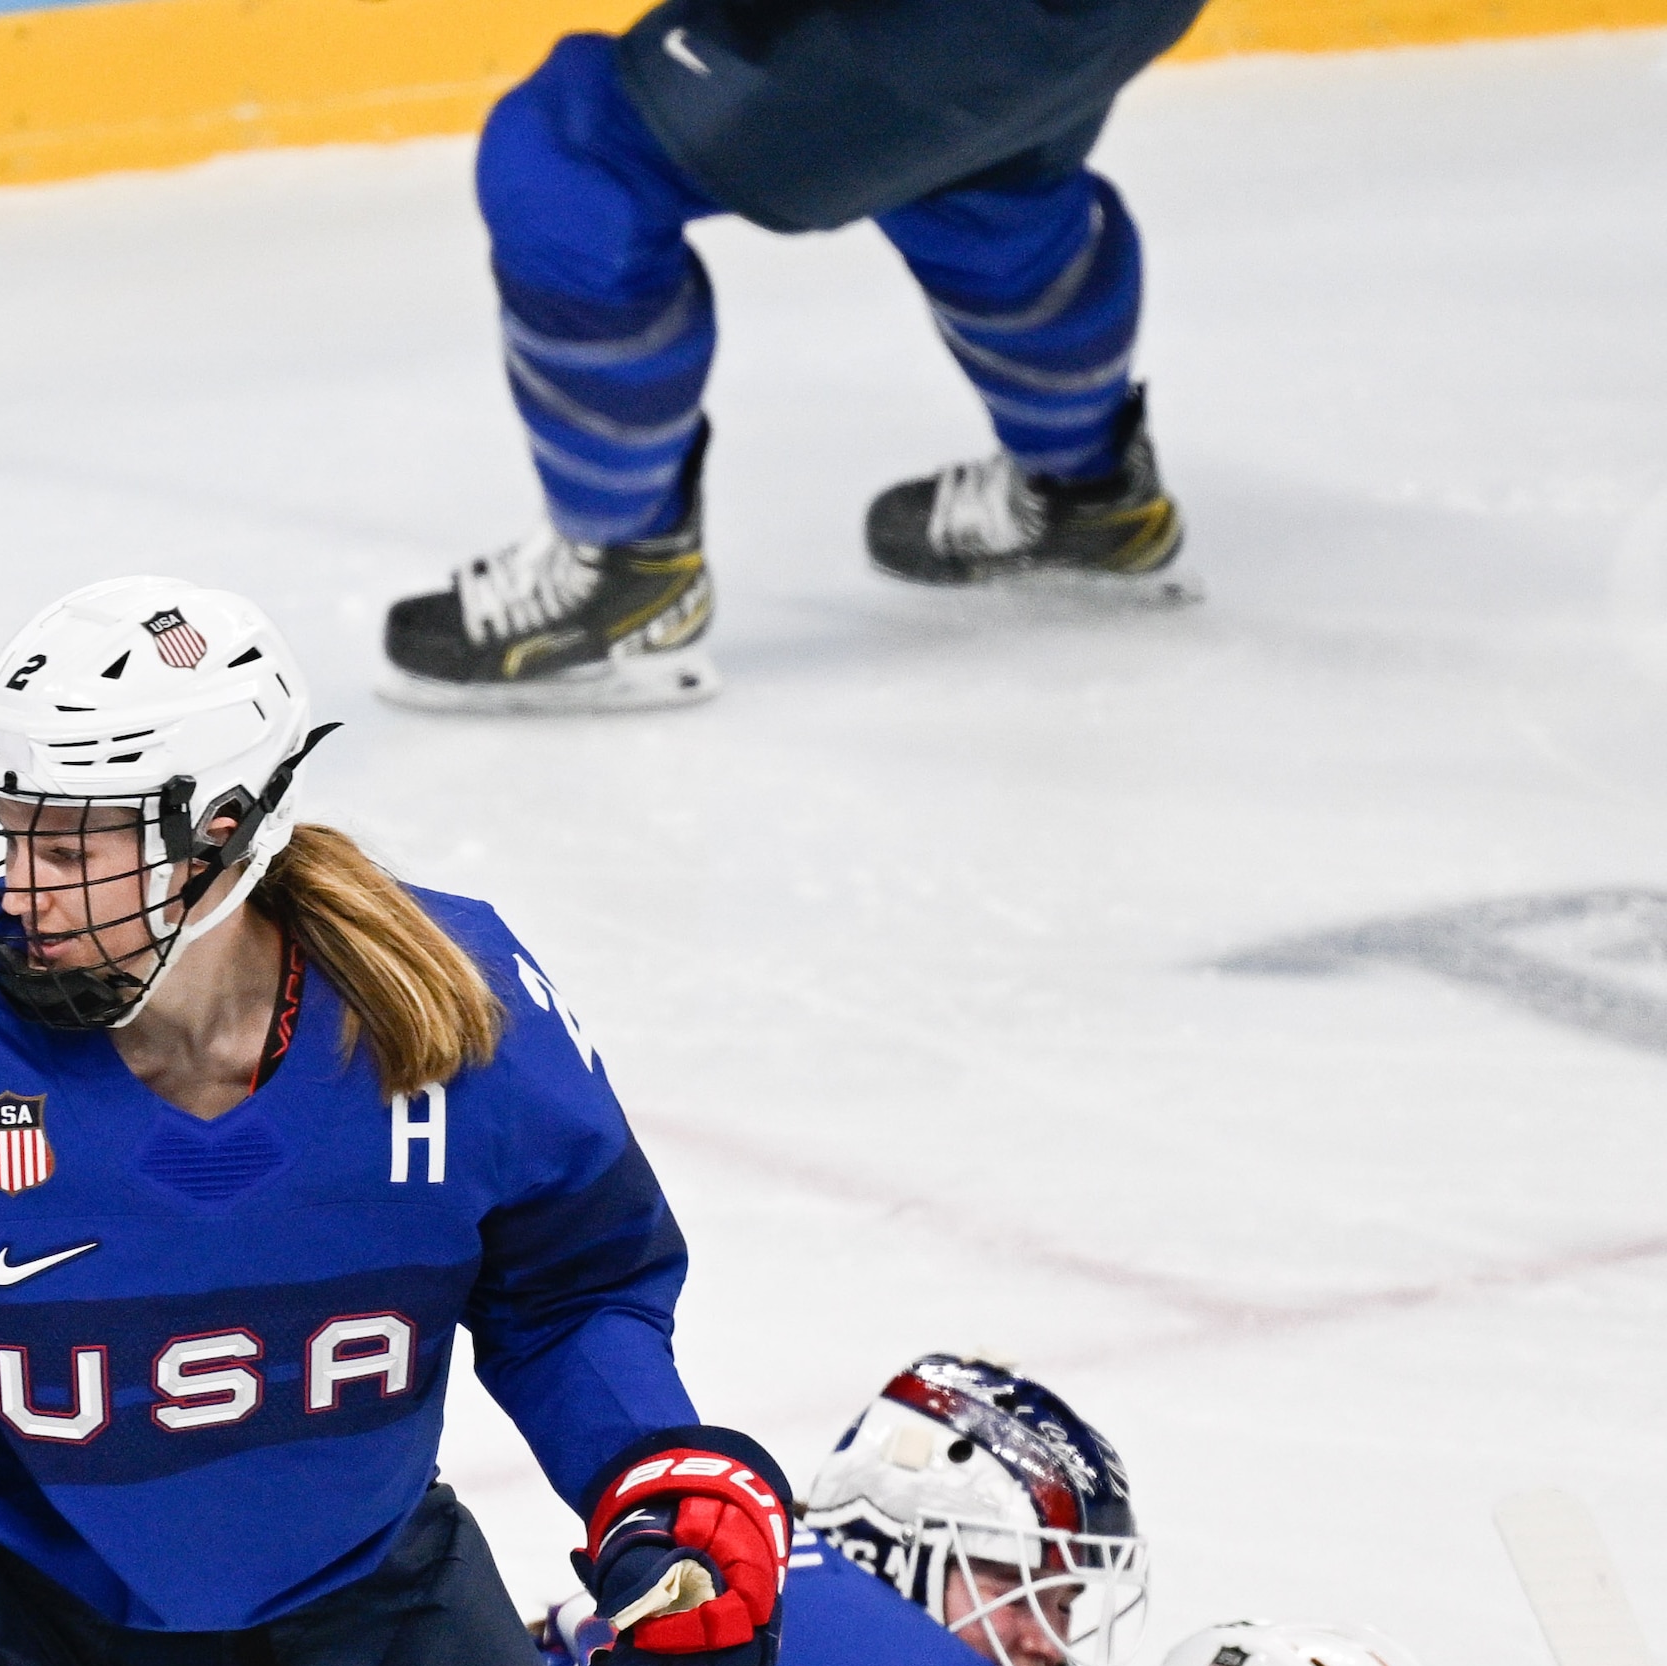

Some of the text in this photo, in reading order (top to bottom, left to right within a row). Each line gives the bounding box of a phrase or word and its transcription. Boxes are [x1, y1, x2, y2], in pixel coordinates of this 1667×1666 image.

[148, 613, 182, 633] USA
[5, 654, 47, 691] 2
[390, 1082, 446, 1184] A
